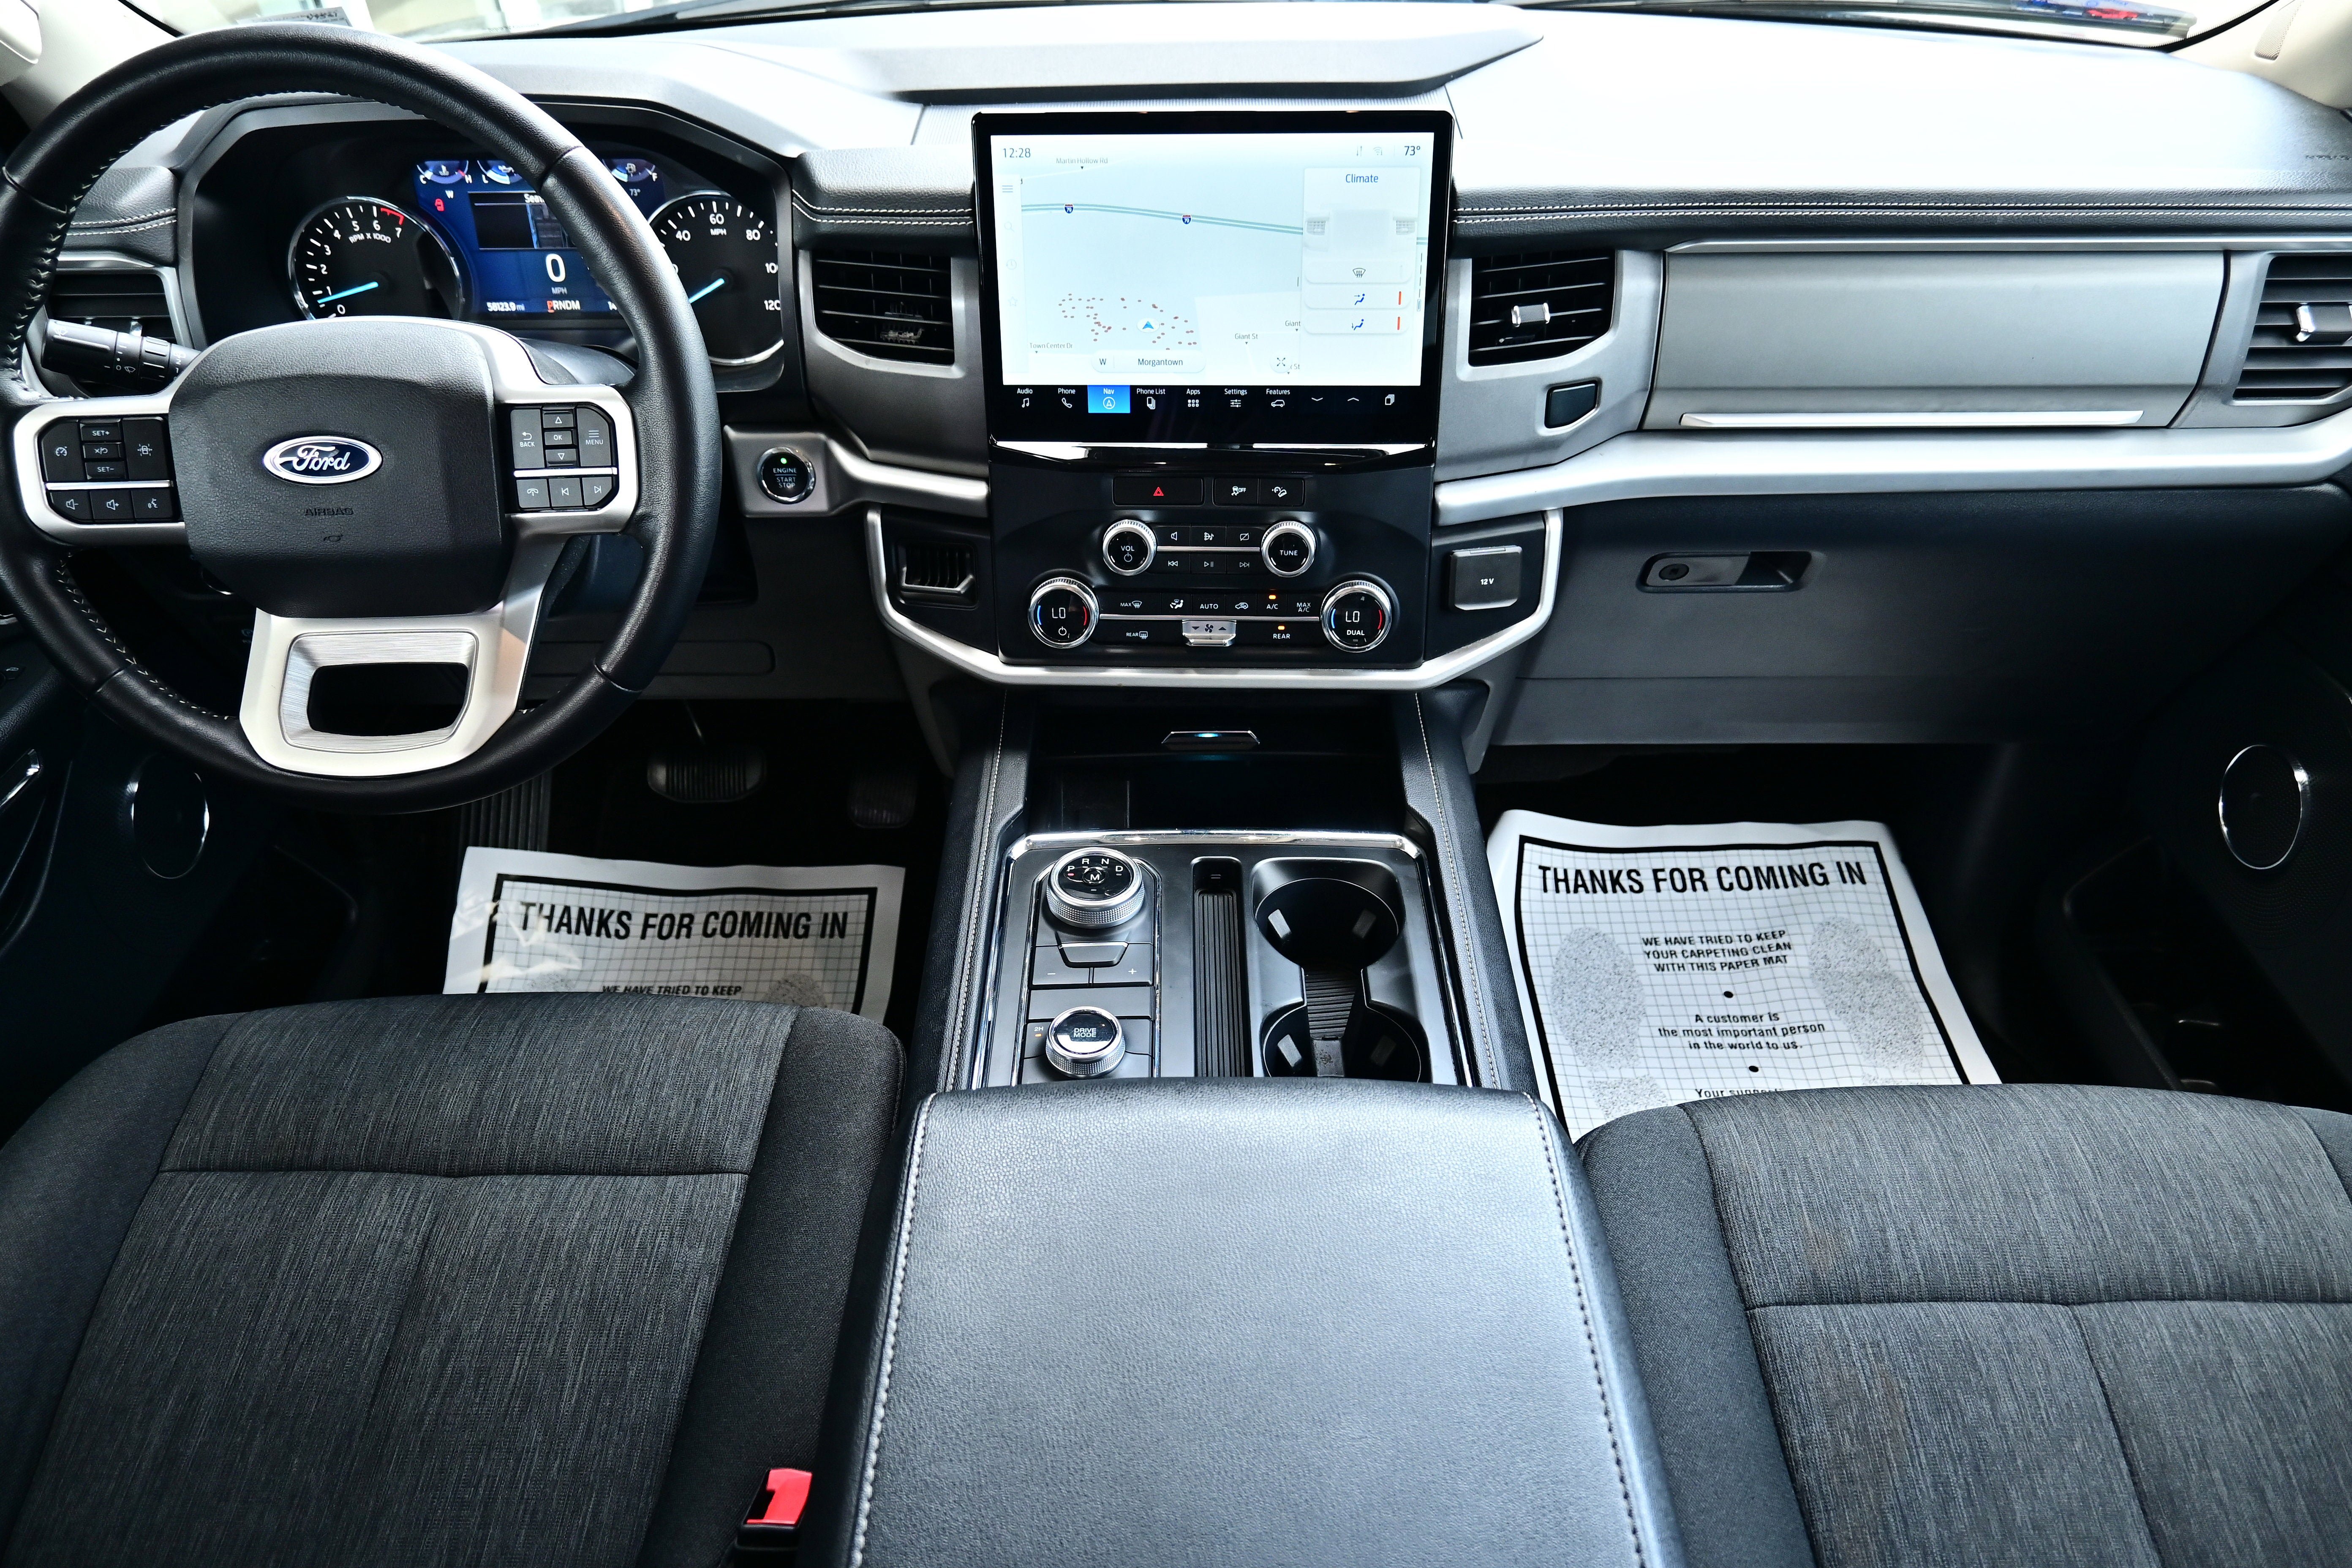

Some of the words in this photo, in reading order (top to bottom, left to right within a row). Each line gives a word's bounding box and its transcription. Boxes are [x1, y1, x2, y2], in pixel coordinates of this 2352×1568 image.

[1002, 148, 1031, 158] 12:28
[1404, 146, 1421, 156] 73°
[465, 174, 472, 183] H
[482, 174, 489, 183] L
[652, 173, 657, 182] F
[1345, 174, 1378, 183] Climate
[709, 214, 724, 225] 60
[351, 220, 360, 231] 5
[373, 220, 381, 231] 6
[333, 230, 341, 240] 4
[348, 233, 365, 244] RPM
[373, 233, 391, 243] 1000
[395, 228, 402, 238] 7
[676, 231, 691, 241] 40
[746, 230, 761, 241] 80
[324, 245, 331, 256] 3
[321, 264, 328, 275] 2
[545, 253, 566, 282] 0
[765, 263, 778, 273] 10
[327, 286, 332, 296] 1
[337, 305, 346, 315] 0
[1138, 358, 1183, 367] Morgantown
[292, 445, 351, 471] Ford
[305, 507, 354, 516] AIRBAG
[1052, 607, 1066, 619] LO
[1345, 611, 1360, 622] LO
[1538, 865, 1644, 894] THANKS
[1652, 867, 1708, 893] FOR
[1716, 862, 1829, 891] COMING
[1836, 861, 1867, 885] IN
[520, 901, 632, 939] THANKS
[640, 913, 695, 940] FOR
[702, 911, 811, 939] COMING
[820, 912, 848, 939] IN
[1642, 936, 1661, 946] WE
[1665, 936, 1695, 945] HAVE
[1697, 934, 1733, 945] TRIED
[1738, 934, 1753, 944] TO
[1756, 929, 1786, 941] KEEP
[1644, 949, 1677, 960] YOUR
[1681, 947, 1749, 959] CARPETING
[1753, 942, 1792, 955] CLEAN
[1654, 962, 1686, 972] WITH
[1688, 961, 1717, 972] THIS
[1721, 959, 1759, 971] PAPER
[1763, 955, 1788, 965] MAT
[623, 986, 653, 994] HAVE
[657, 986, 690, 995] TRIED
[694, 986, 709, 996] TO
[712, 986, 742, 996] KEEP
[1695, 1015, 1704, 1023] A
[1707, 1013, 1764, 1023] customer
[1768, 1012, 1780, 1022] is
[1658, 1027, 1679, 1037] the
[1682, 1026, 1712, 1037] most
[1716, 1026, 1778, 1039] important
[1781, 1022, 1825, 1037] person
[1689, 1040, 1701, 1050] in
[1704, 1040, 1724, 1049] the
[1728, 1040, 1764, 1050] world
[1766, 1040, 1780, 1049] to
[1695, 1089, 1724, 1098] Your
